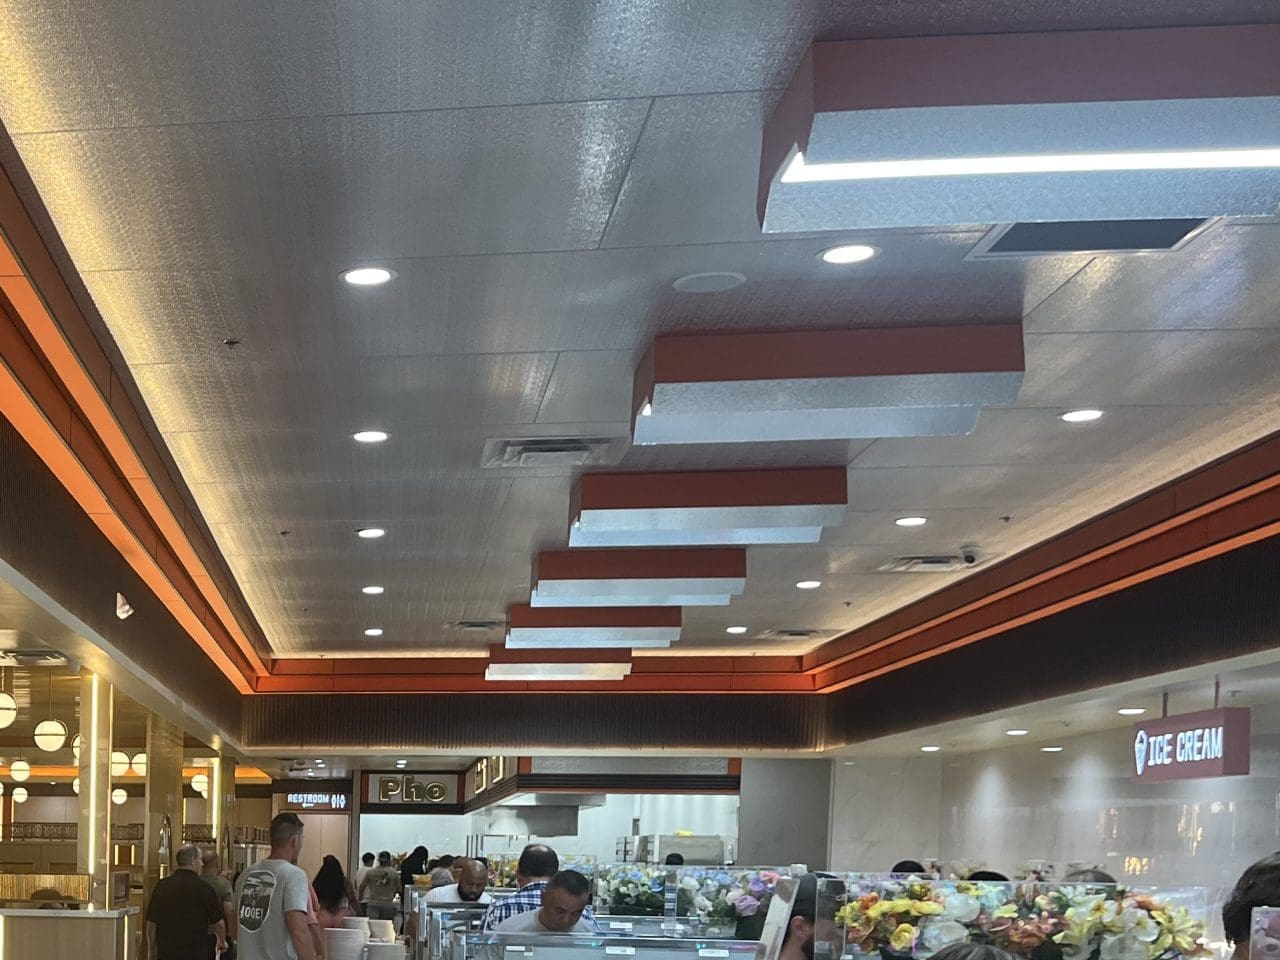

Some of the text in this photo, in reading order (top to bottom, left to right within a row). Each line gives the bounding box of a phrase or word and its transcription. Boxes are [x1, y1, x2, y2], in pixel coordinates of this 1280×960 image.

[1147, 726, 1223, 766] ICE CREAM
[287, 793, 329, 803] RESTROOM
[379, 775, 448, 802] Pho
